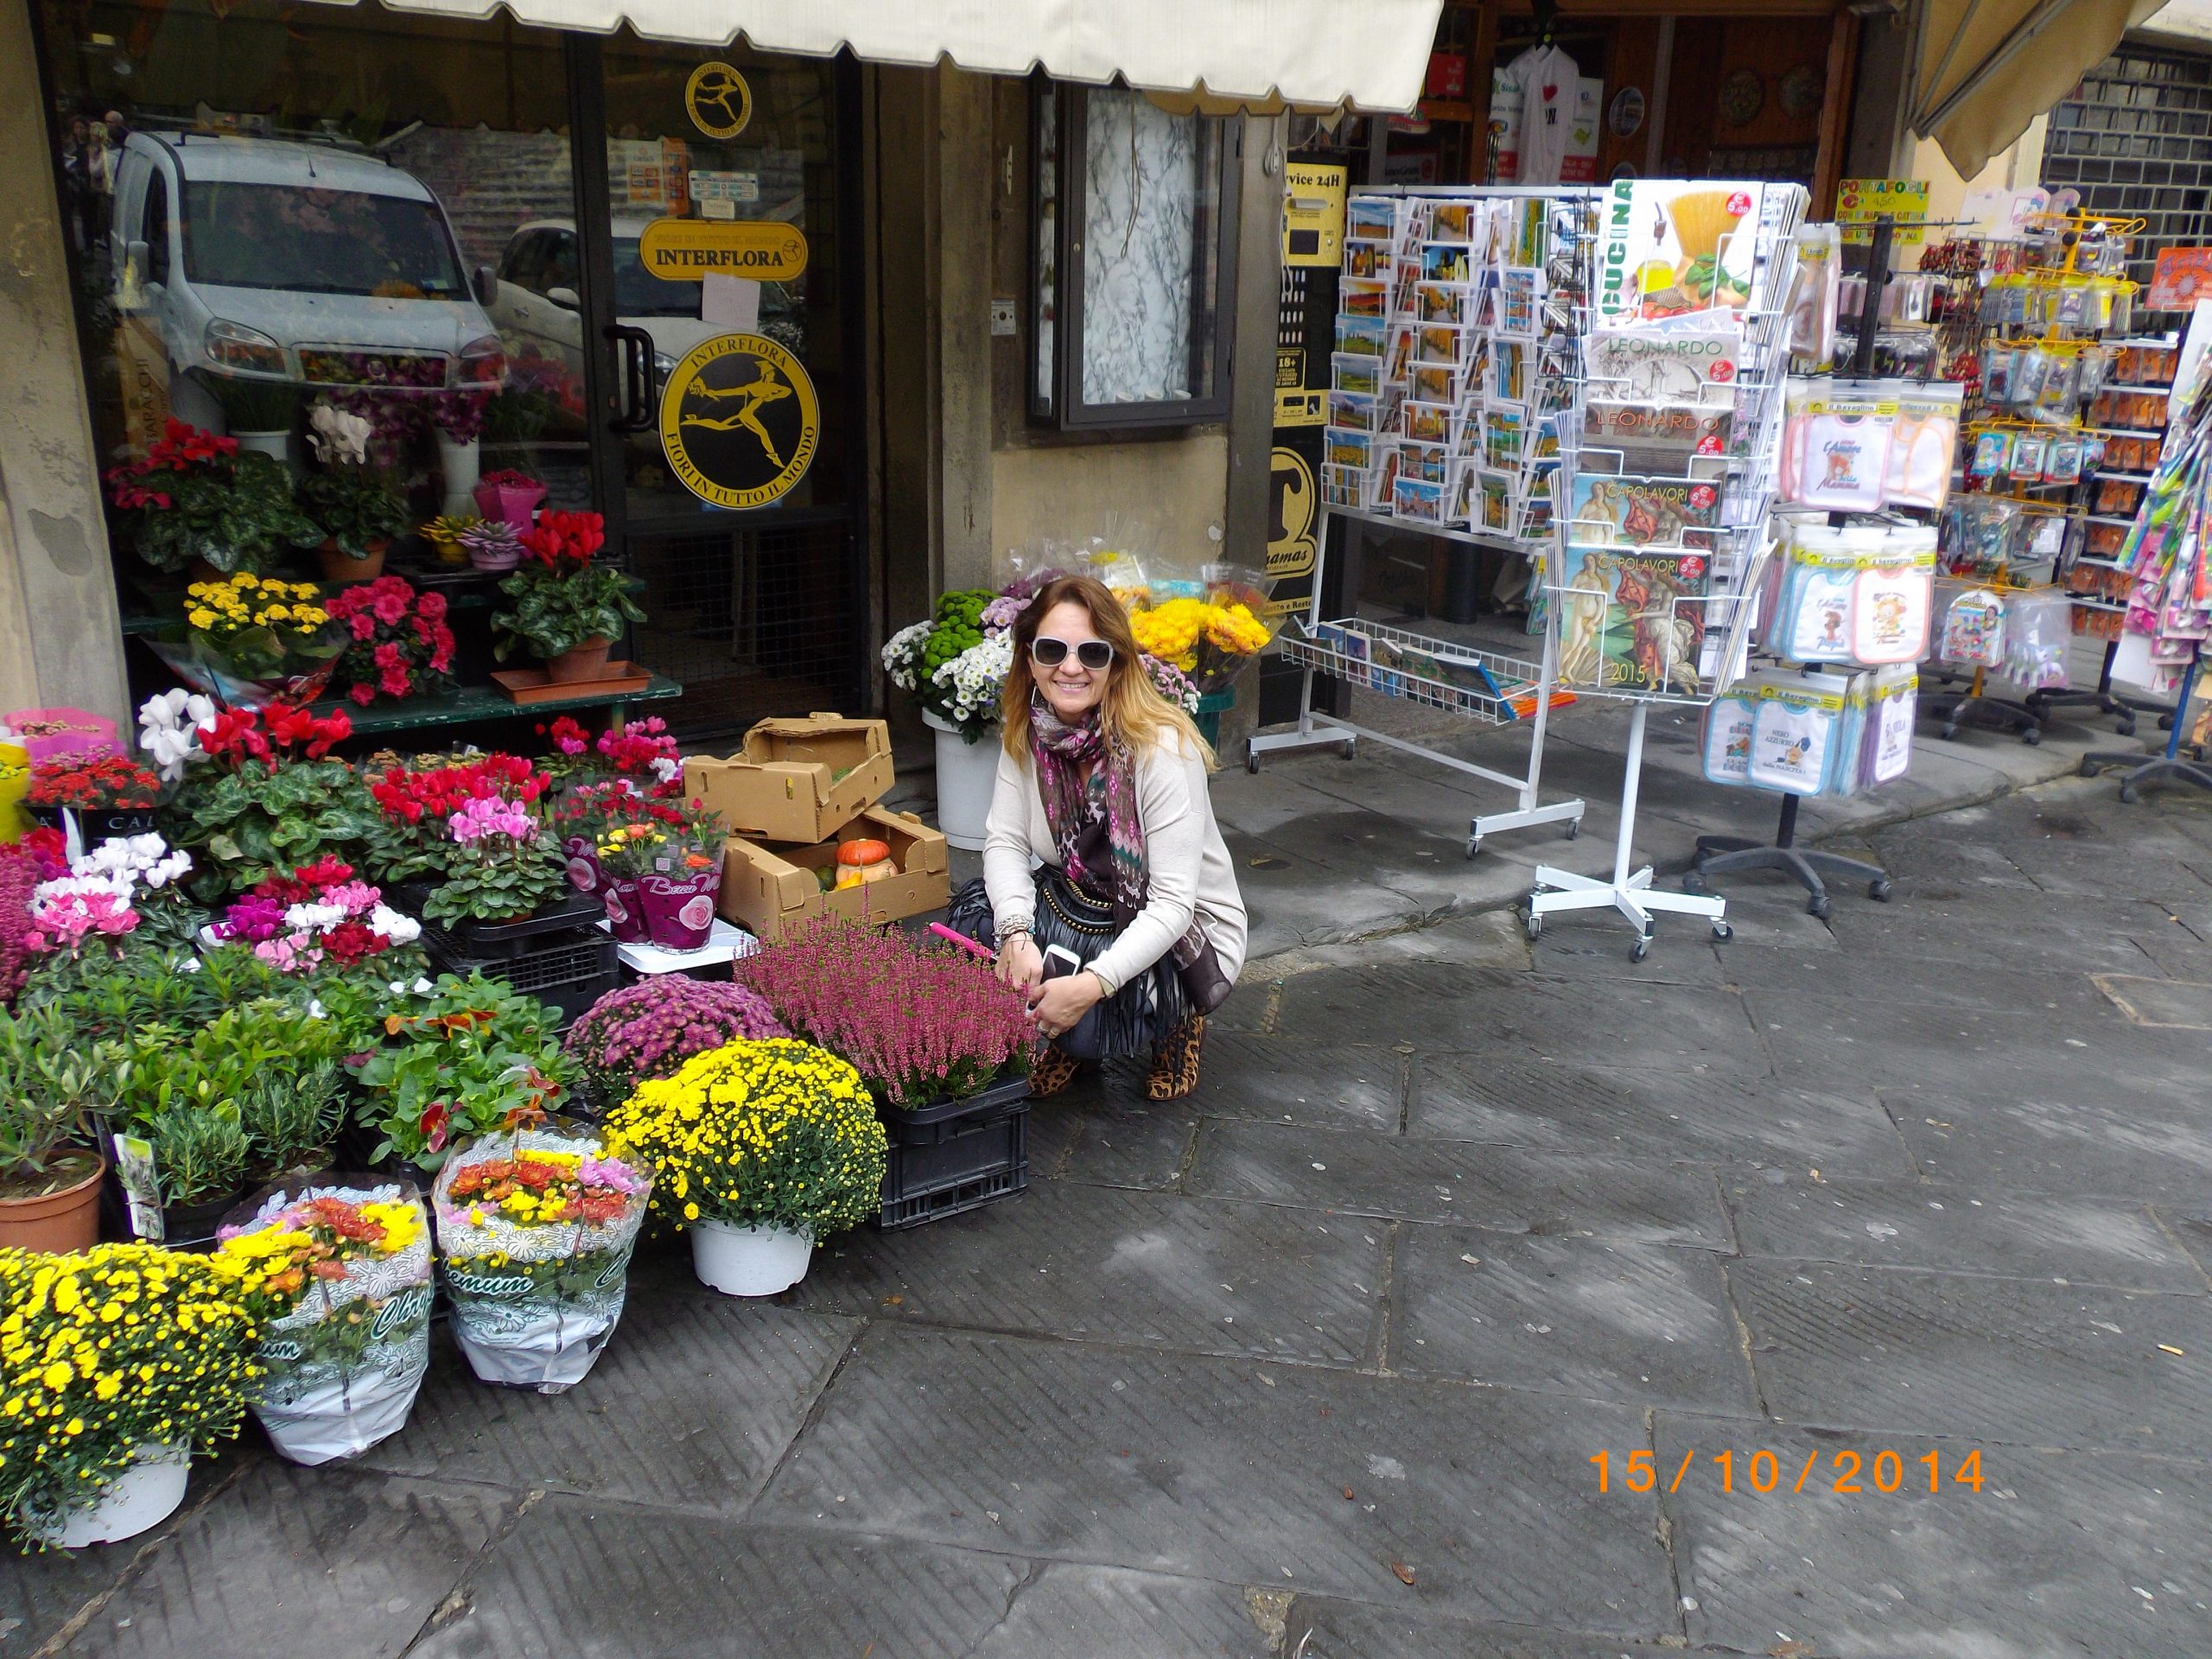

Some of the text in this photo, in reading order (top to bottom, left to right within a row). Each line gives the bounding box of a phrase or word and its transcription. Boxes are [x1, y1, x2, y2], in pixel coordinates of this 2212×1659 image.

[1287, 174, 1340, 188] vice 24H
[1840, 181, 1931, 194] PORTAFOGLI
[656, 248, 785, 267] INTERFLORA
[1602, 181, 1633, 315] CUCINA
[690, 338, 788, 369] INTERFLORA
[1609, 338, 1723, 355] LEONARDO
[1279, 357, 1296, 367] 18+
[1598, 411, 1719, 430] LEONARDO
[666, 426, 815, 504] FIORI IN TUTTO IL MONDO
[1606, 485, 1688, 501] CAPOLAVORI
[1599, 555, 1679, 573] CAPOLAVORI
[1611, 663, 1646, 683] 2015
[1772, 729, 1789, 739] NERO
[641, 875, 697, 895] Beau
[442, 1257, 536, 1295] hemum
[371, 1290, 434, 1340] Chry
